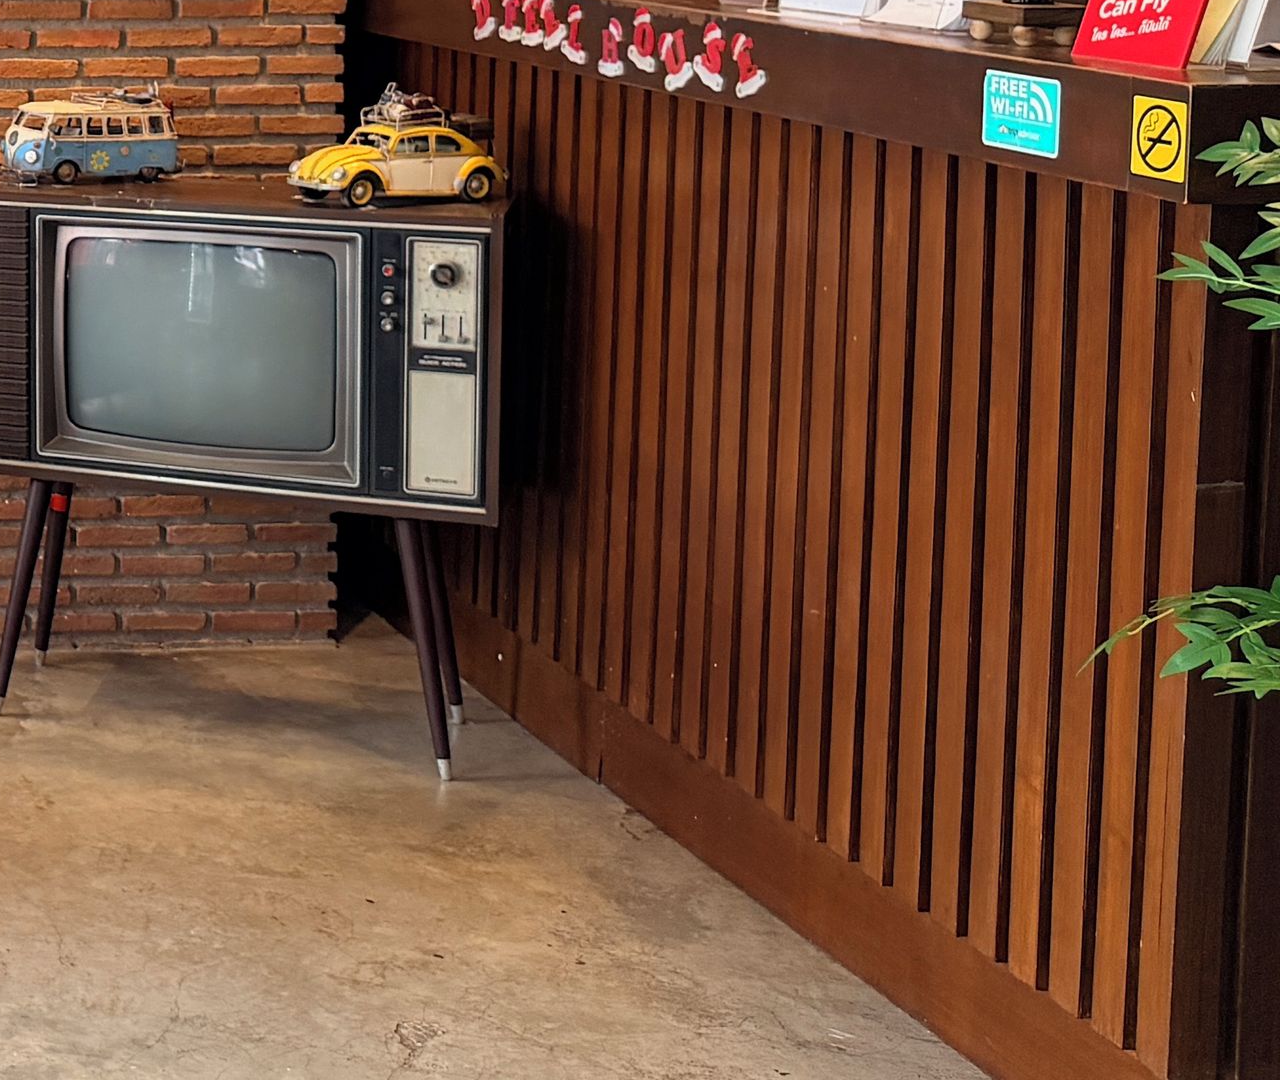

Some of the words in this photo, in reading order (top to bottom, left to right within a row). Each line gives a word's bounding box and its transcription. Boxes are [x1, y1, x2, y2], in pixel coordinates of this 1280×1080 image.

[600, 15, 762, 89] HOUSE
[991, 77, 1028, 96] FREE
[990, 95, 1028, 119] WI-FI
